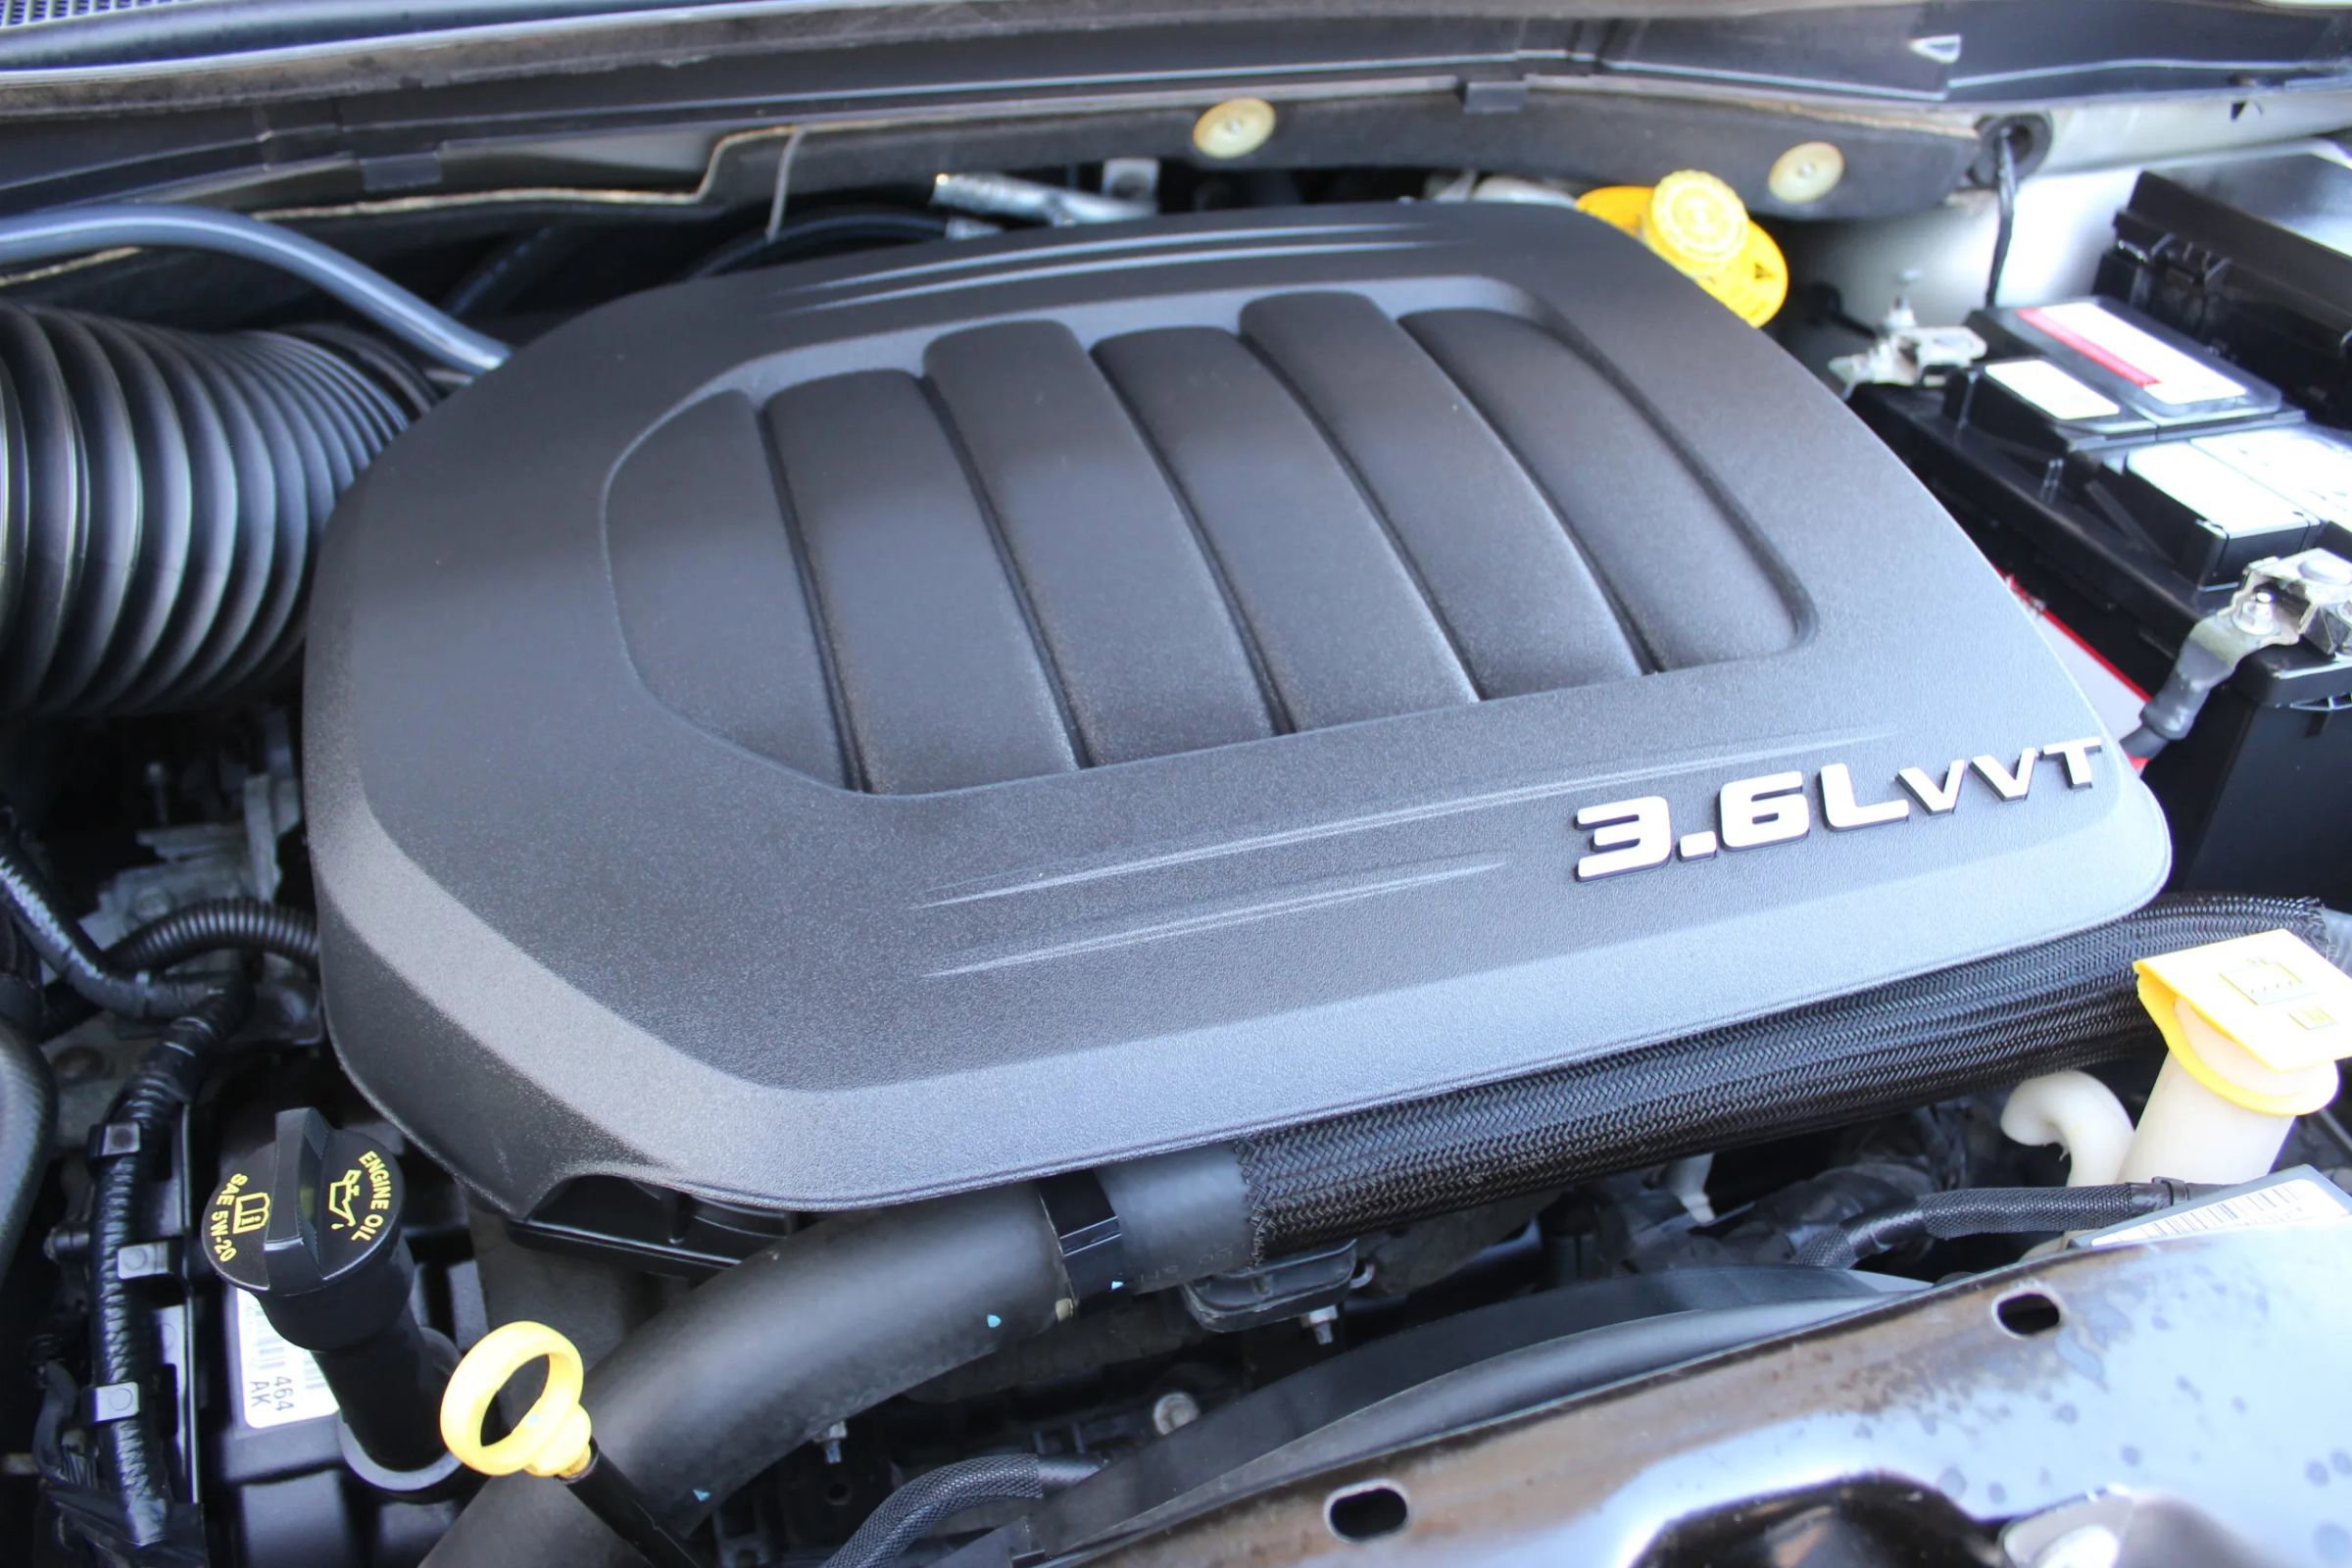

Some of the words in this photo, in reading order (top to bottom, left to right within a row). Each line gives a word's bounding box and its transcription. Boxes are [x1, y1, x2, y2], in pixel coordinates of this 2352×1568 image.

[216, 1172, 248, 1206] SAE
[358, 1150, 392, 1210] ENGINE
[210, 1210, 237, 1262] 5W-20
[351, 1213, 384, 1243] OIL
[250, 1381, 271, 1407] AK
[273, 1376, 295, 1412] 464
